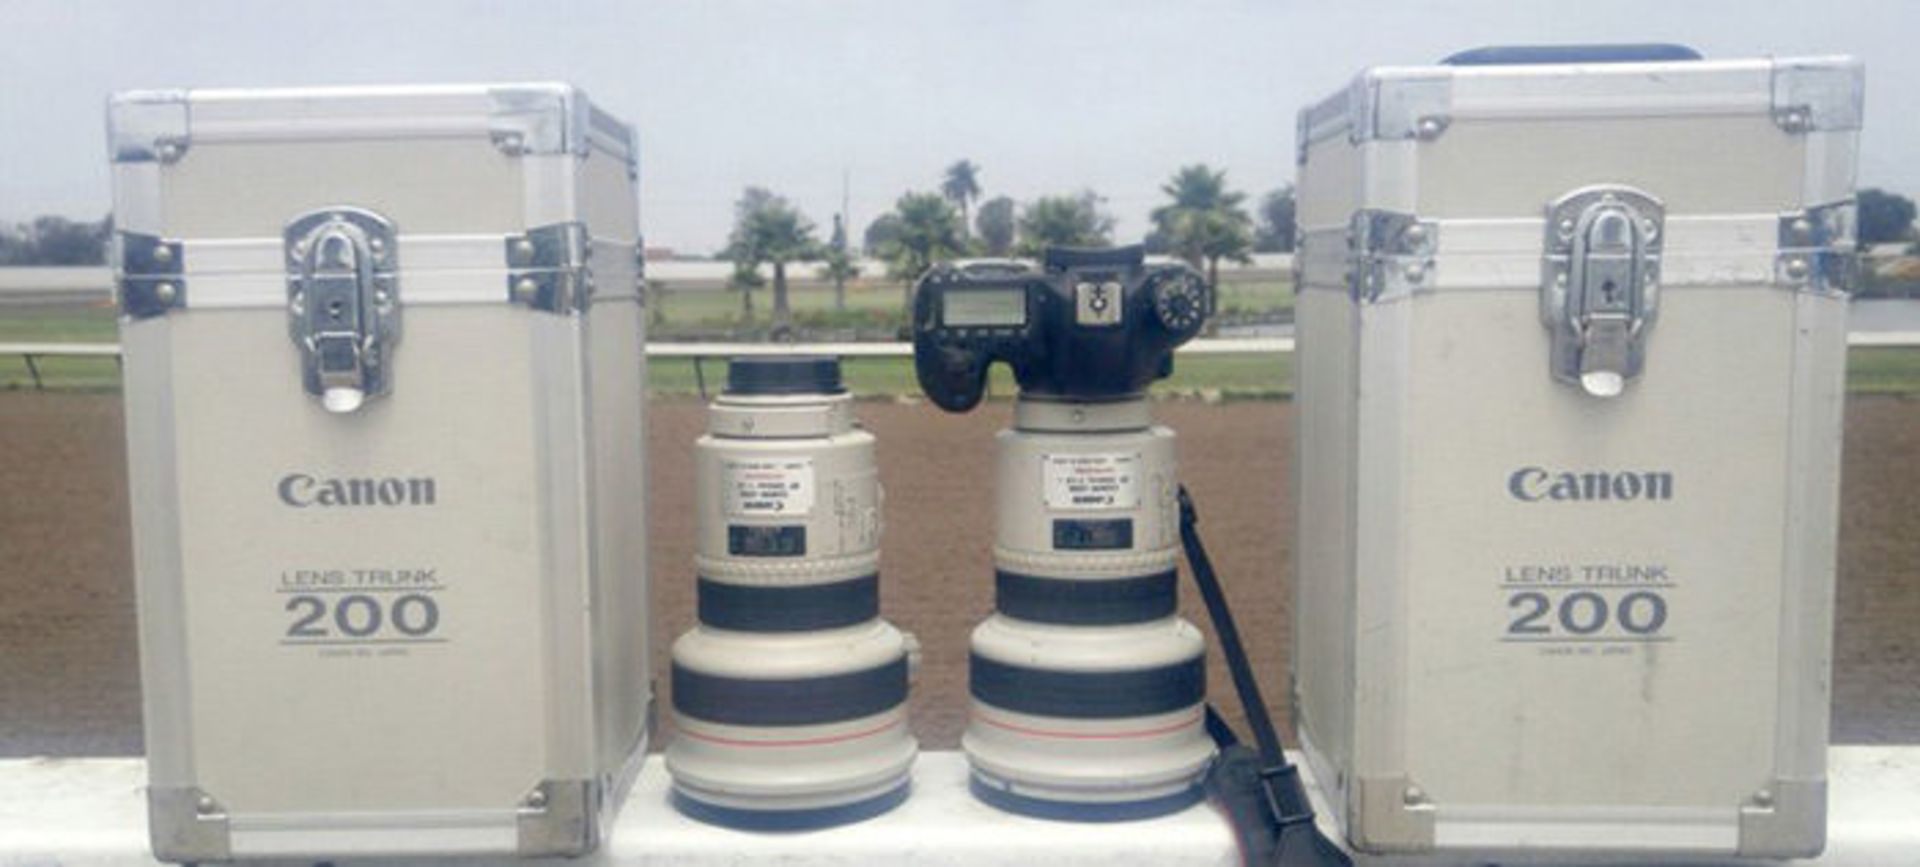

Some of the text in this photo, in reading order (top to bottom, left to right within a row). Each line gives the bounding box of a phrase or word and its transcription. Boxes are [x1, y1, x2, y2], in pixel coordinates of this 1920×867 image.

[277, 473, 436, 508] Canon
[1508, 466, 1673, 501] Canon
[281, 568, 438, 585] LENS TRUNK
[1505, 565, 1668, 582] LENS TRUNK
[285, 594, 439, 637] 200
[1507, 591, 1668, 634] 200
